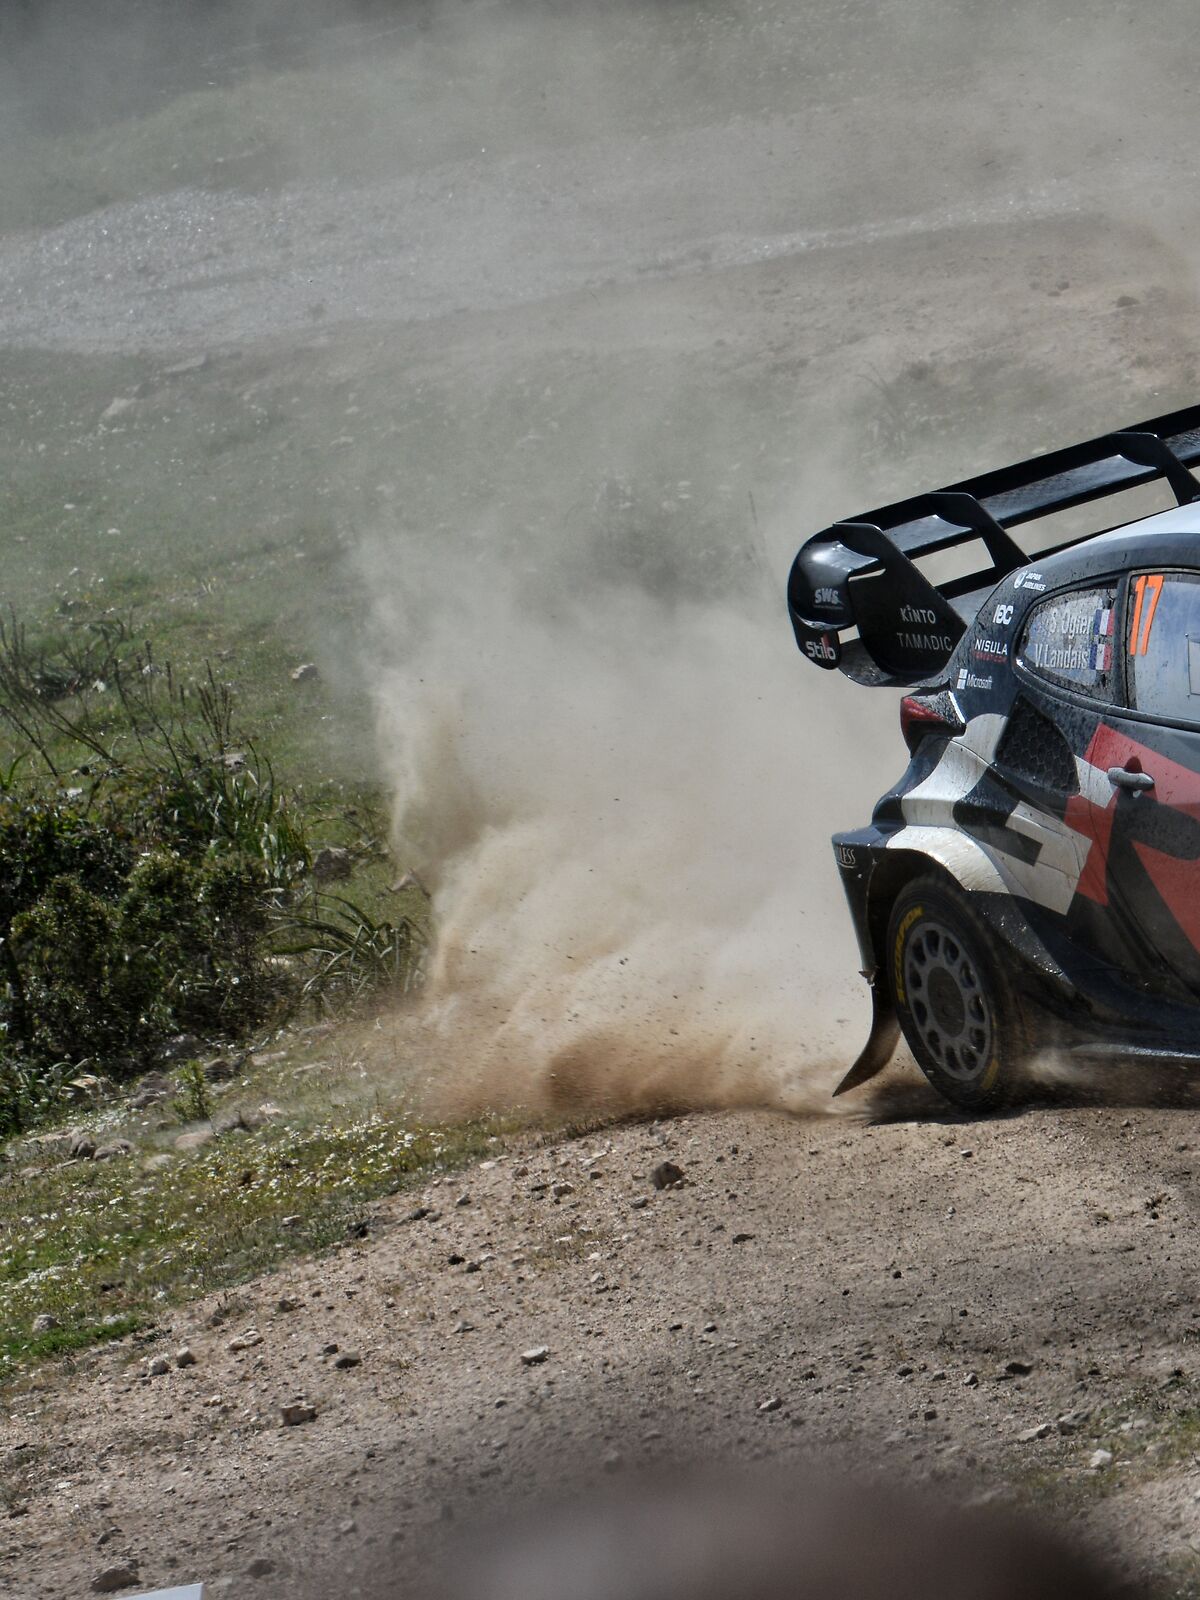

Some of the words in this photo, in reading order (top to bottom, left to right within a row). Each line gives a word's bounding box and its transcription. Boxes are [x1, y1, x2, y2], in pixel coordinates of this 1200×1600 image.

[1130, 575, 1164, 656] 17
[896, 632, 953, 652] TAMADIC
[974, 638, 1008, 656] NISULA
[966, 673, 993, 690] Microsoft
